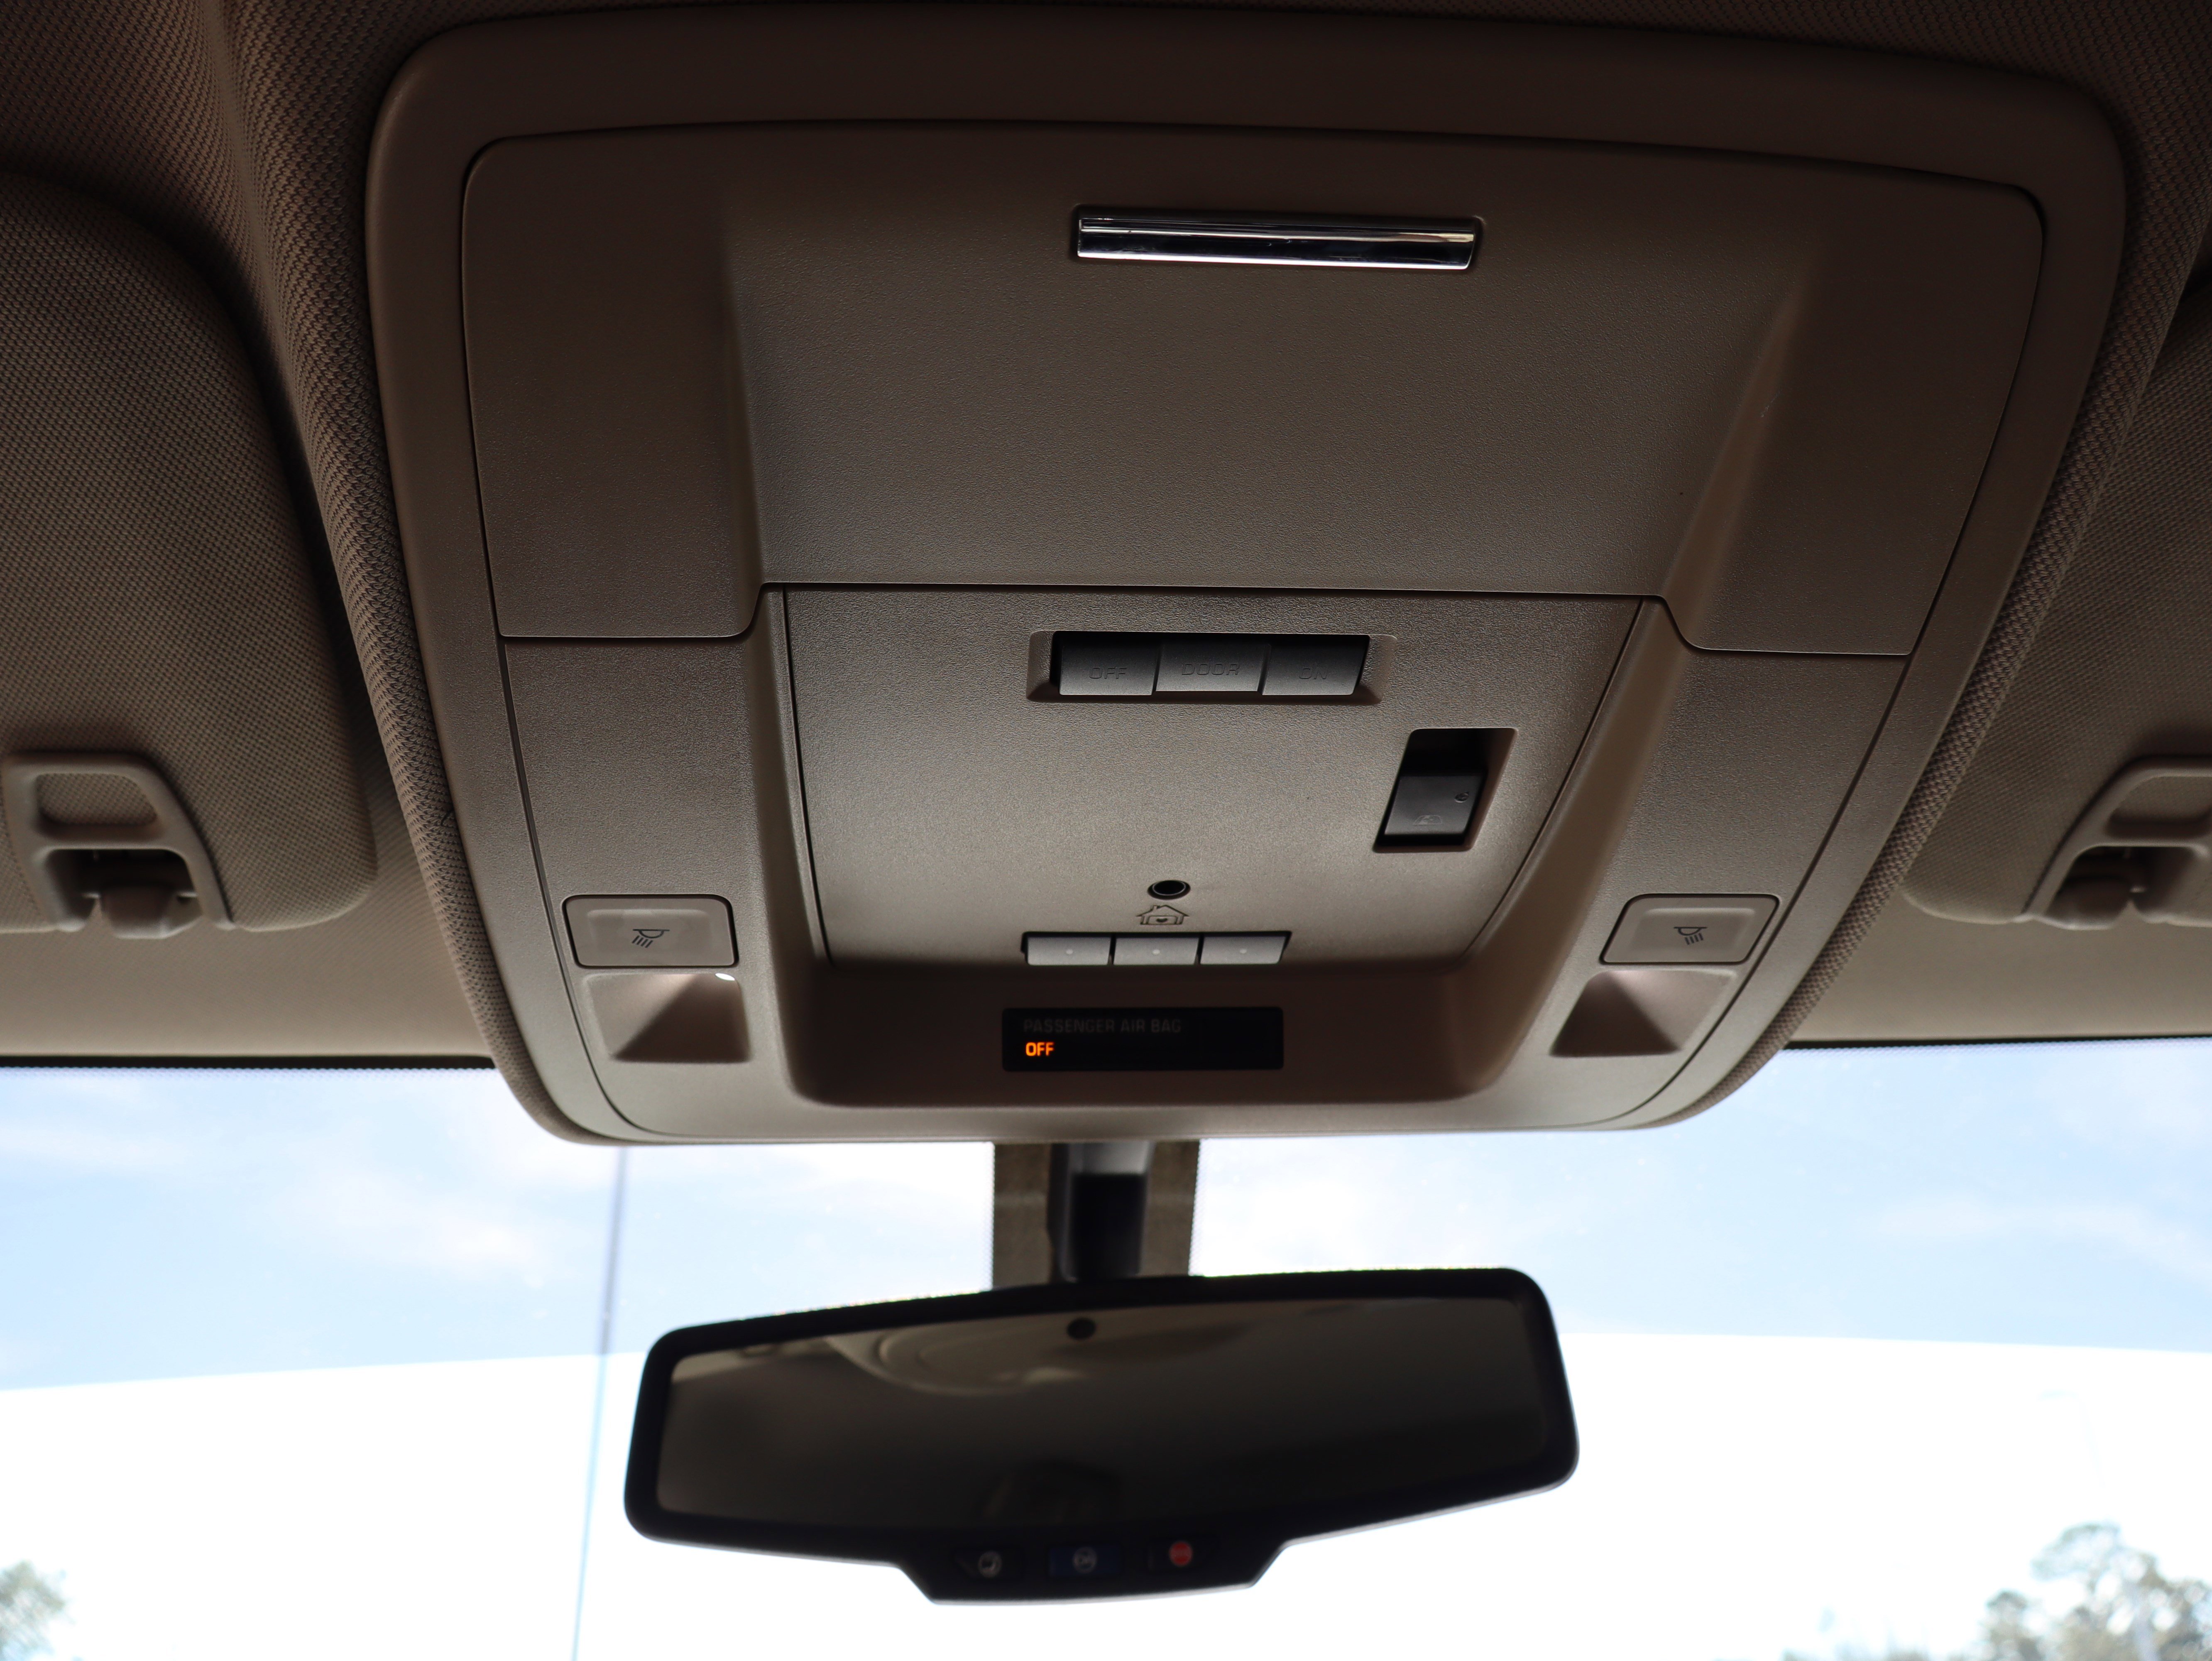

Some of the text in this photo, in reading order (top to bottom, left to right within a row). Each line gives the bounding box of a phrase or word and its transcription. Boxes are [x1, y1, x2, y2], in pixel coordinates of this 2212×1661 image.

[1089, 663, 1328, 680] OFF DOOR ON
[1023, 1019, 1181, 1033] PASSENGER AIR BAG
[1025, 1042, 1054, 1056] OFF
